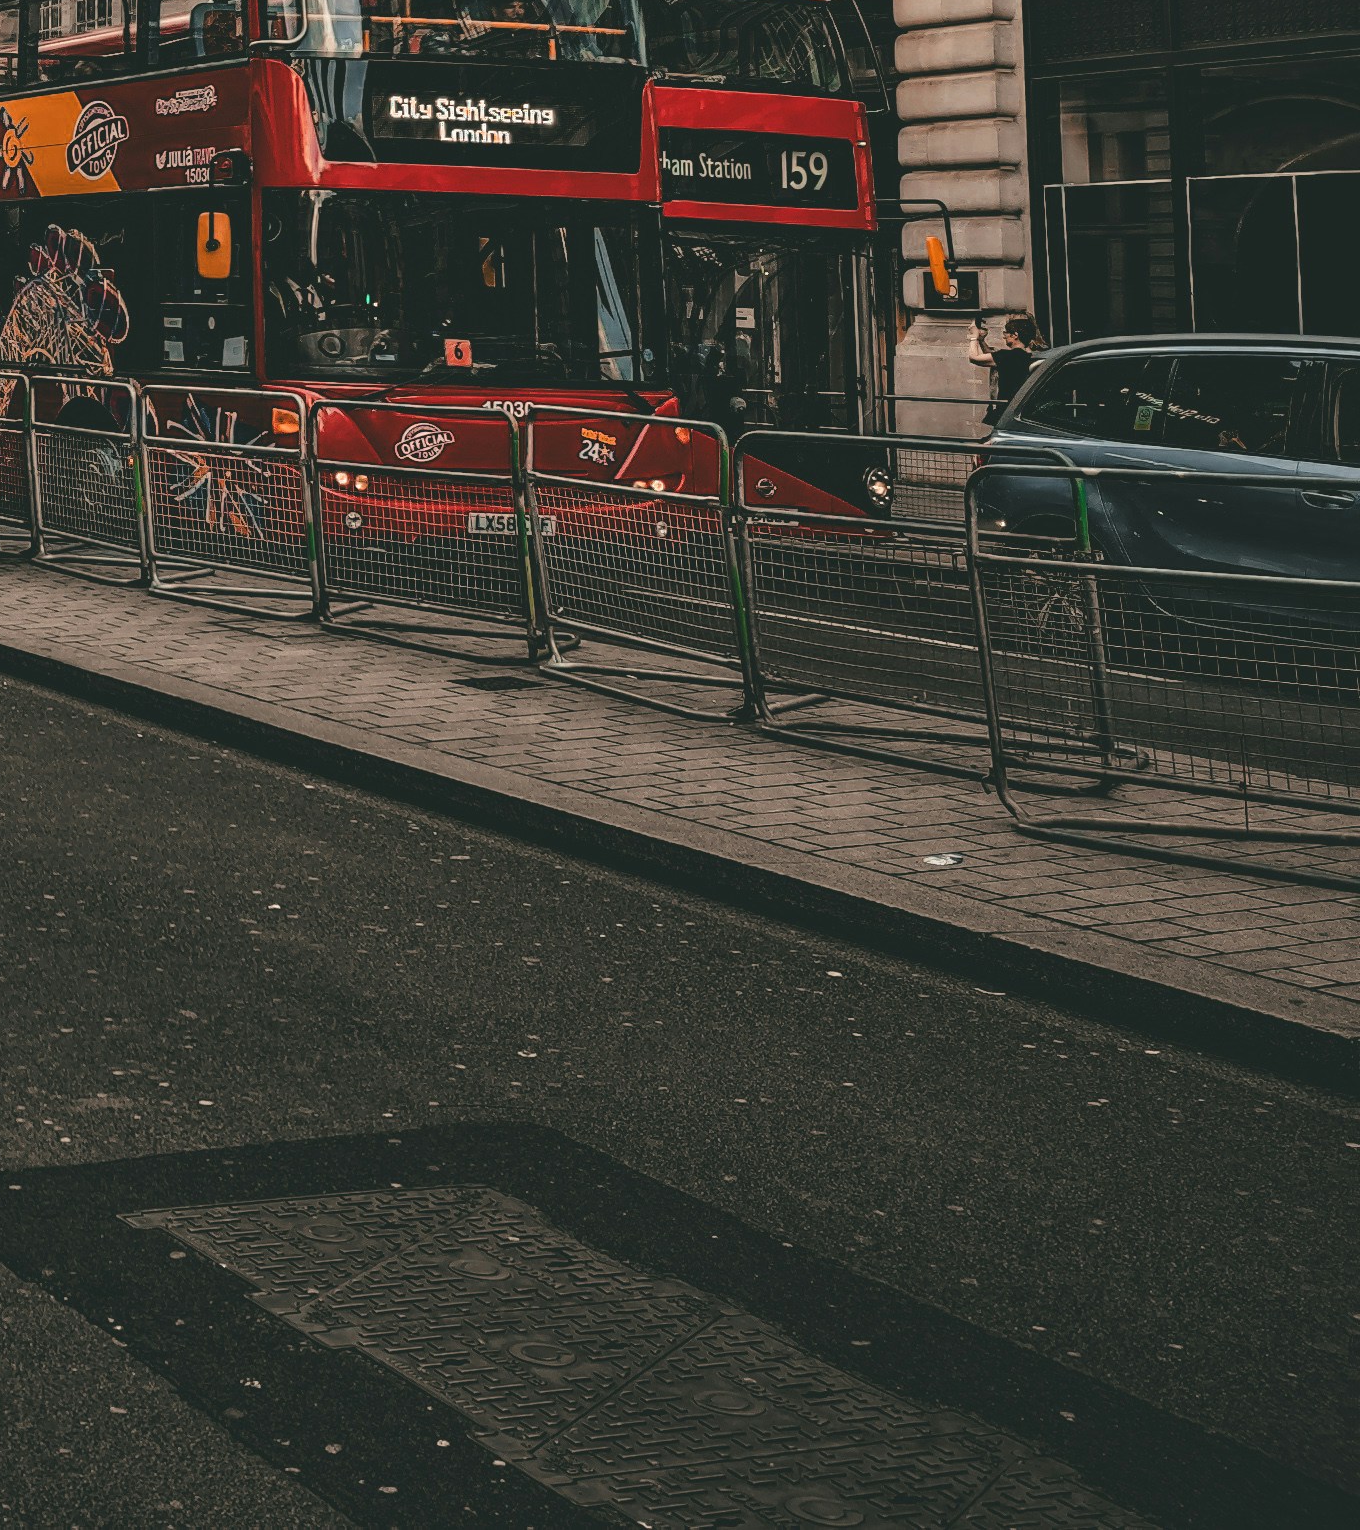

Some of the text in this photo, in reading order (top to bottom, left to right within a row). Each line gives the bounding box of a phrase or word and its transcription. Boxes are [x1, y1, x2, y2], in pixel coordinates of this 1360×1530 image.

[389, 95, 554, 124] City Sightseeing
[72, 120, 126, 164] OFFICIAL
[439, 121, 510, 145] London
[89, 149, 114, 174] TOUR
[659, 151, 828, 191] ham Station 159
[453, 341, 464, 360] 6
[401, 432, 451, 455] OFFICIAL
[418, 446, 440, 459] TOUR
